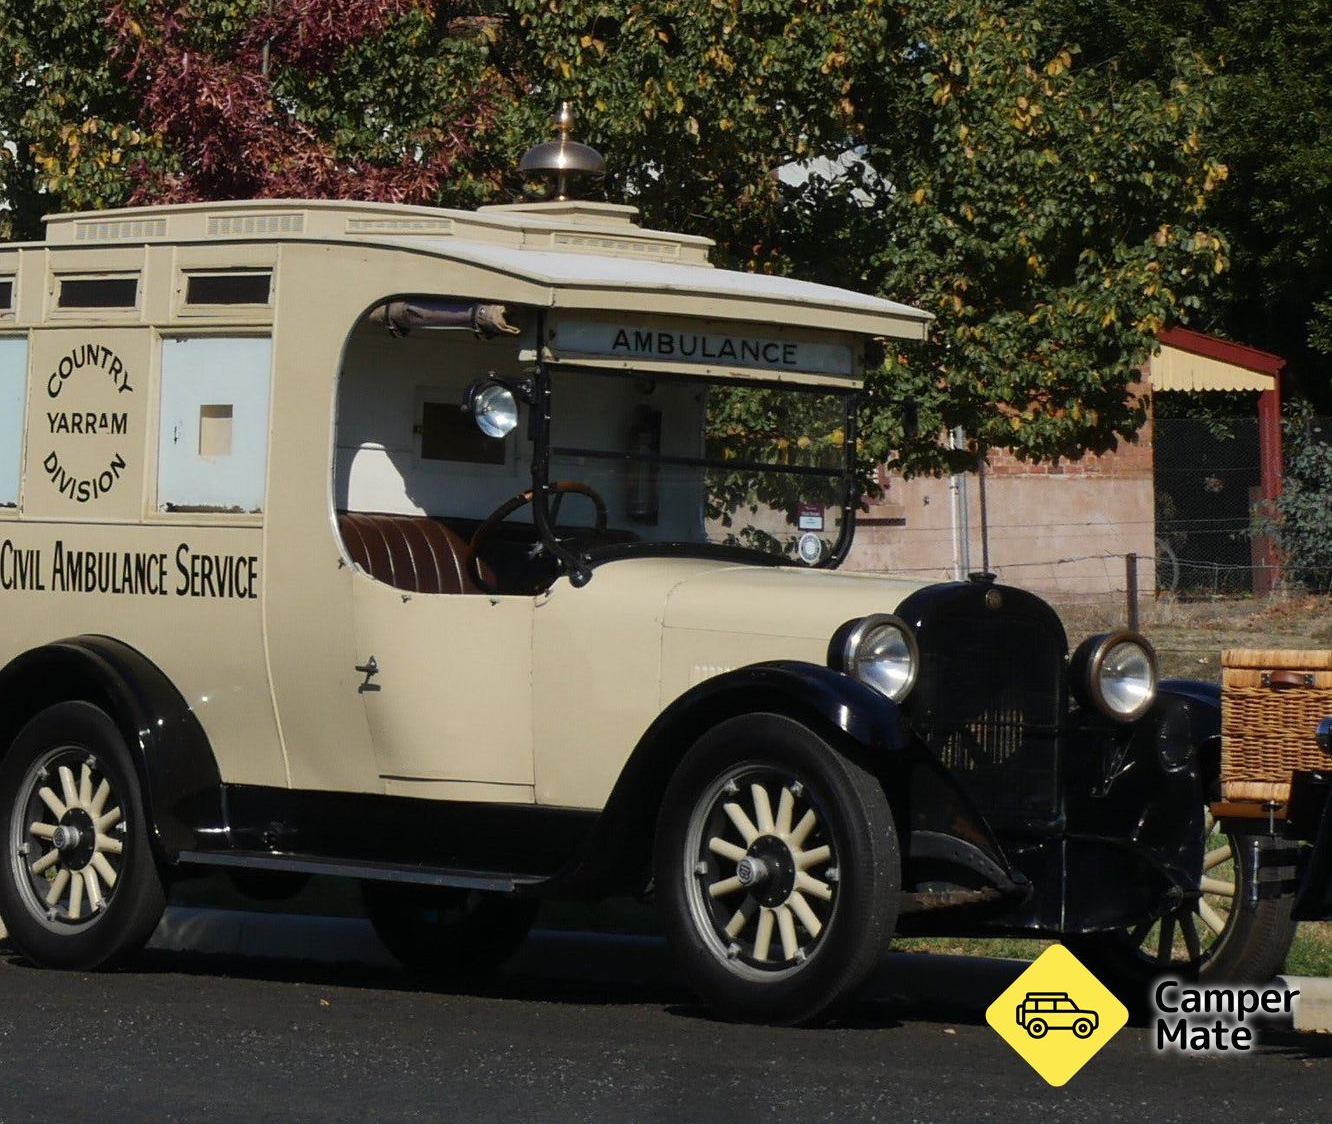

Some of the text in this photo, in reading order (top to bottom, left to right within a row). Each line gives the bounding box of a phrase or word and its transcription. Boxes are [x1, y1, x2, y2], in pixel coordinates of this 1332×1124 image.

[47, 344, 133, 398] COUNTRY
[612, 329, 797, 365] AMBULANCE
[47, 412, 128, 434] YARRAM
[43, 450, 126, 503] DIVISION
[0, 539, 45, 591] CIVIL
[52, 540, 168, 595] AMBULANCE
[175, 543, 258, 599] SERVICE
